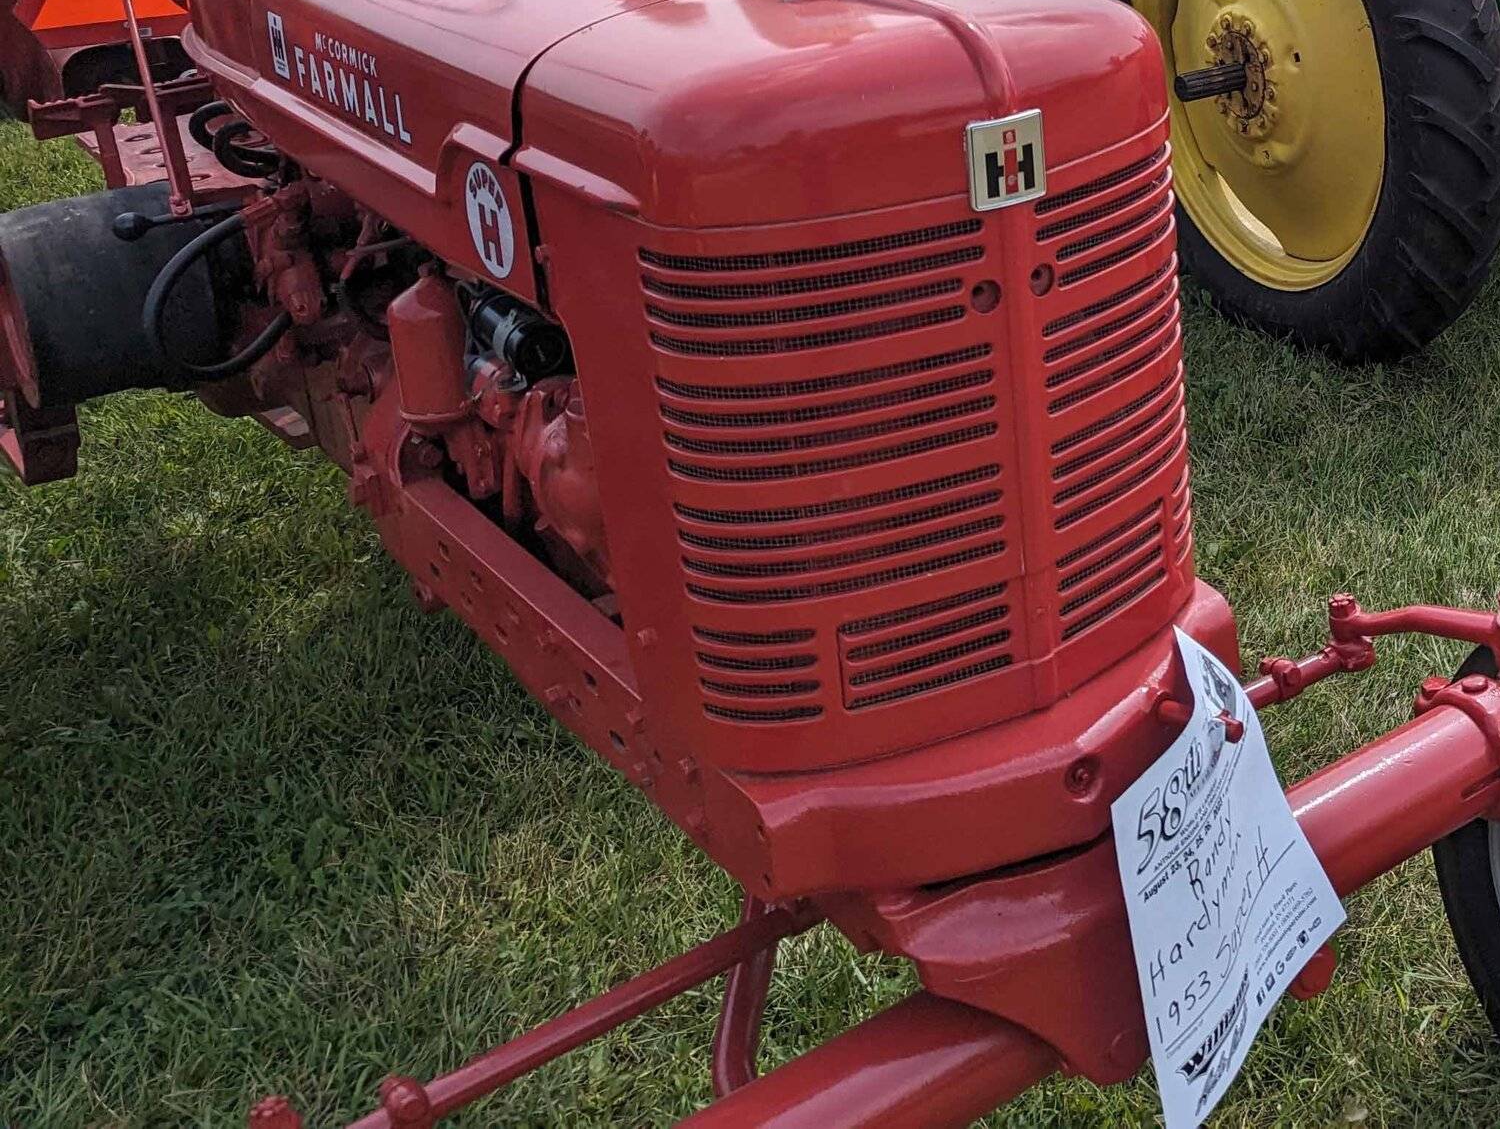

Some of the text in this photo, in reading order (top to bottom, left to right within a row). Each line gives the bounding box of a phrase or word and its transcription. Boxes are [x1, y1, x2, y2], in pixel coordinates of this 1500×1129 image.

[294, 45, 412, 145] FARMALL
[468, 168, 504, 210] SUPER
[478, 202, 504, 269] H
[1143, 870, 1170, 903] August
[1186, 798, 1232, 901] Randy
[1155, 970, 1211, 1044] 1953
[1215, 869, 1253, 979] Super
